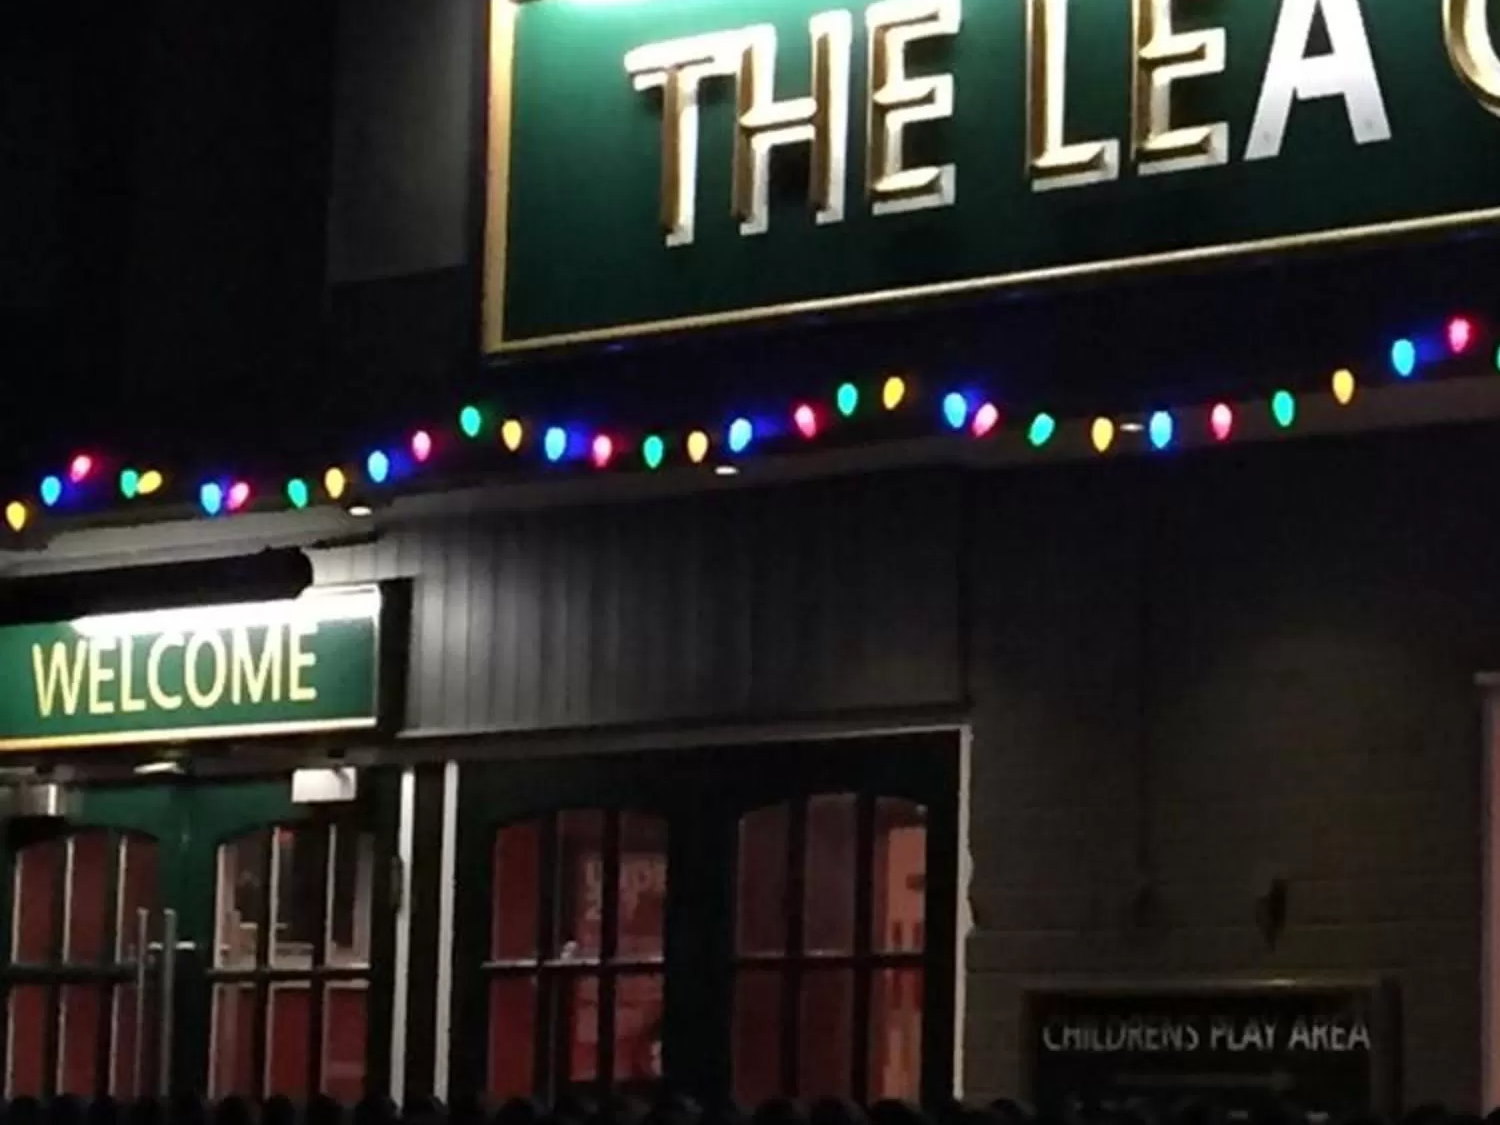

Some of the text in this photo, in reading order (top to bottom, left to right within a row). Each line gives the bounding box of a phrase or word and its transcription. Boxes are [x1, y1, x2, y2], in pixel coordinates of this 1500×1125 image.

[32, 622, 318, 717] WELCOME
[1042, 1015, 1372, 1052] CHILDRENS PLAY AREA
